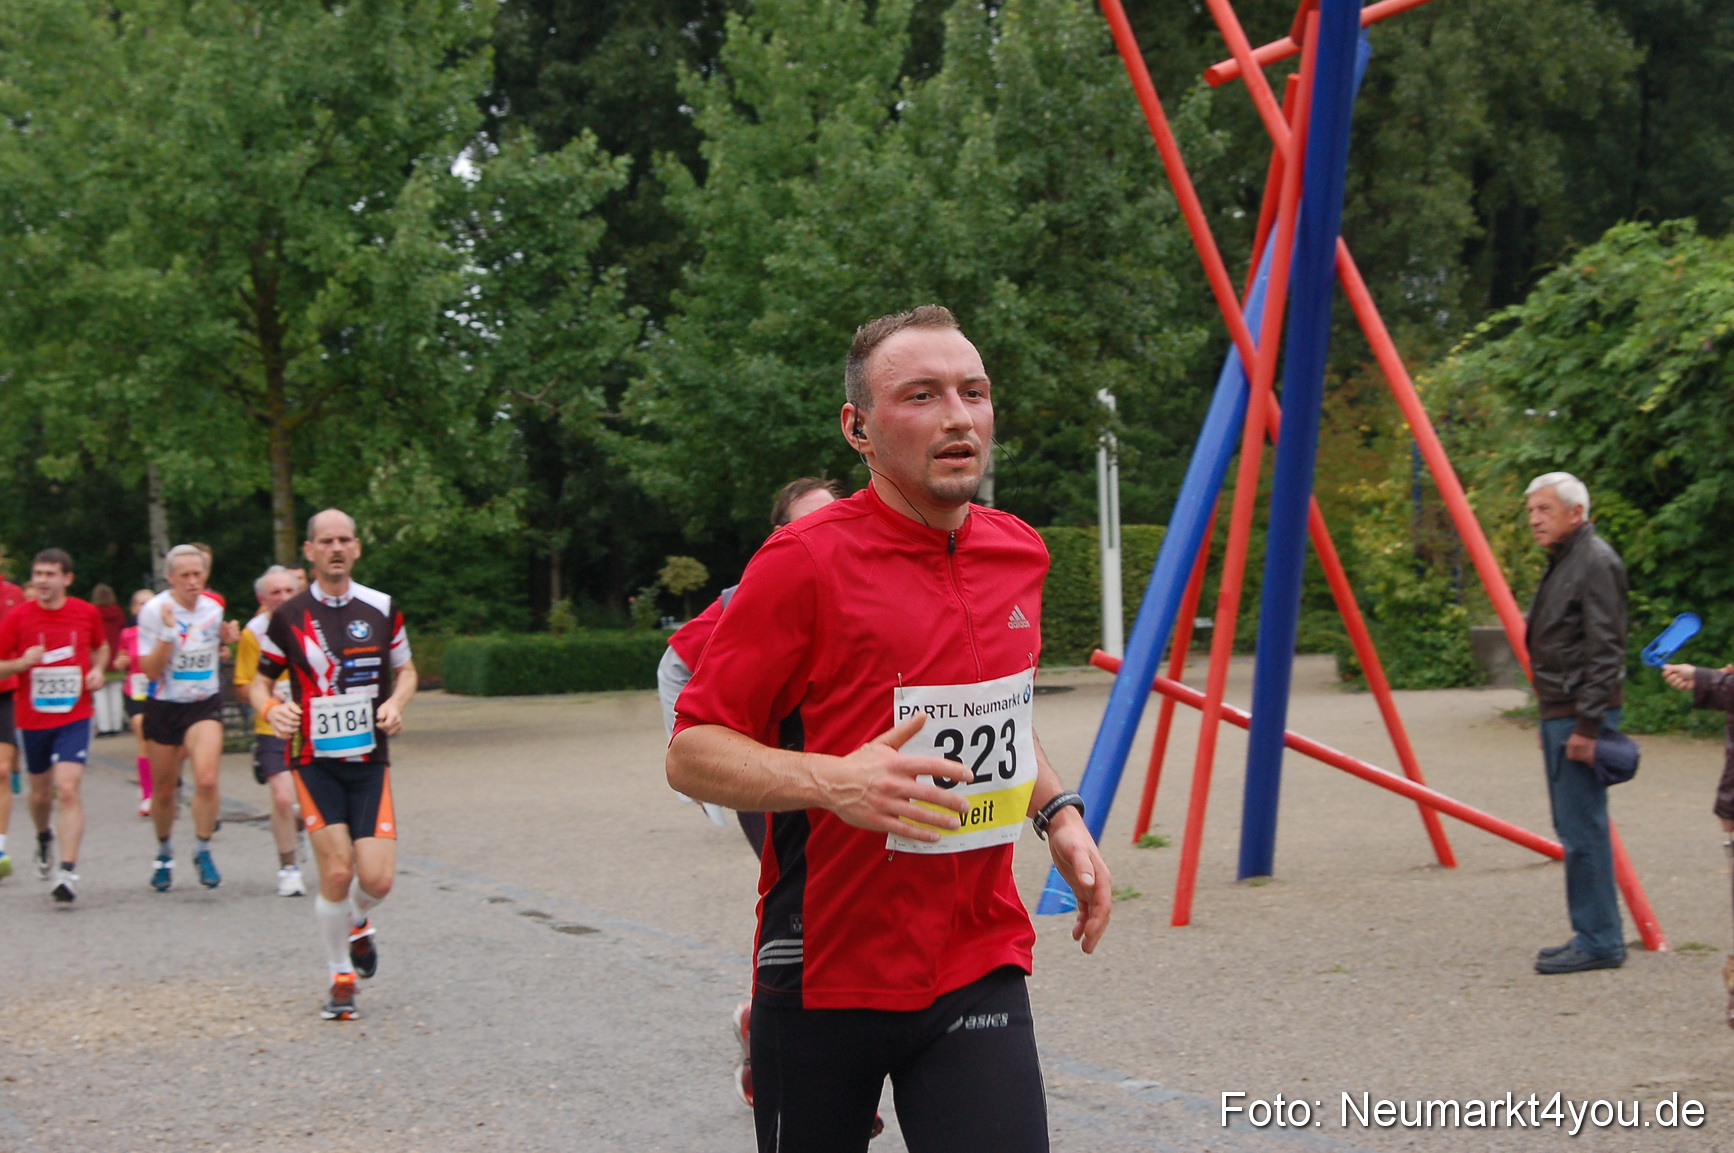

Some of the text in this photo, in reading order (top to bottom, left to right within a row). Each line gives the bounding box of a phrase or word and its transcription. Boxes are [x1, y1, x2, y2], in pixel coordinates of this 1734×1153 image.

[37, 678, 76, 694] 2332
[898, 693, 1021, 720] PARTL Neumarkt
[317, 708, 368, 735] 3184
[931, 718, 1017, 790] 323
[964, 1012, 1009, 1030] asics
